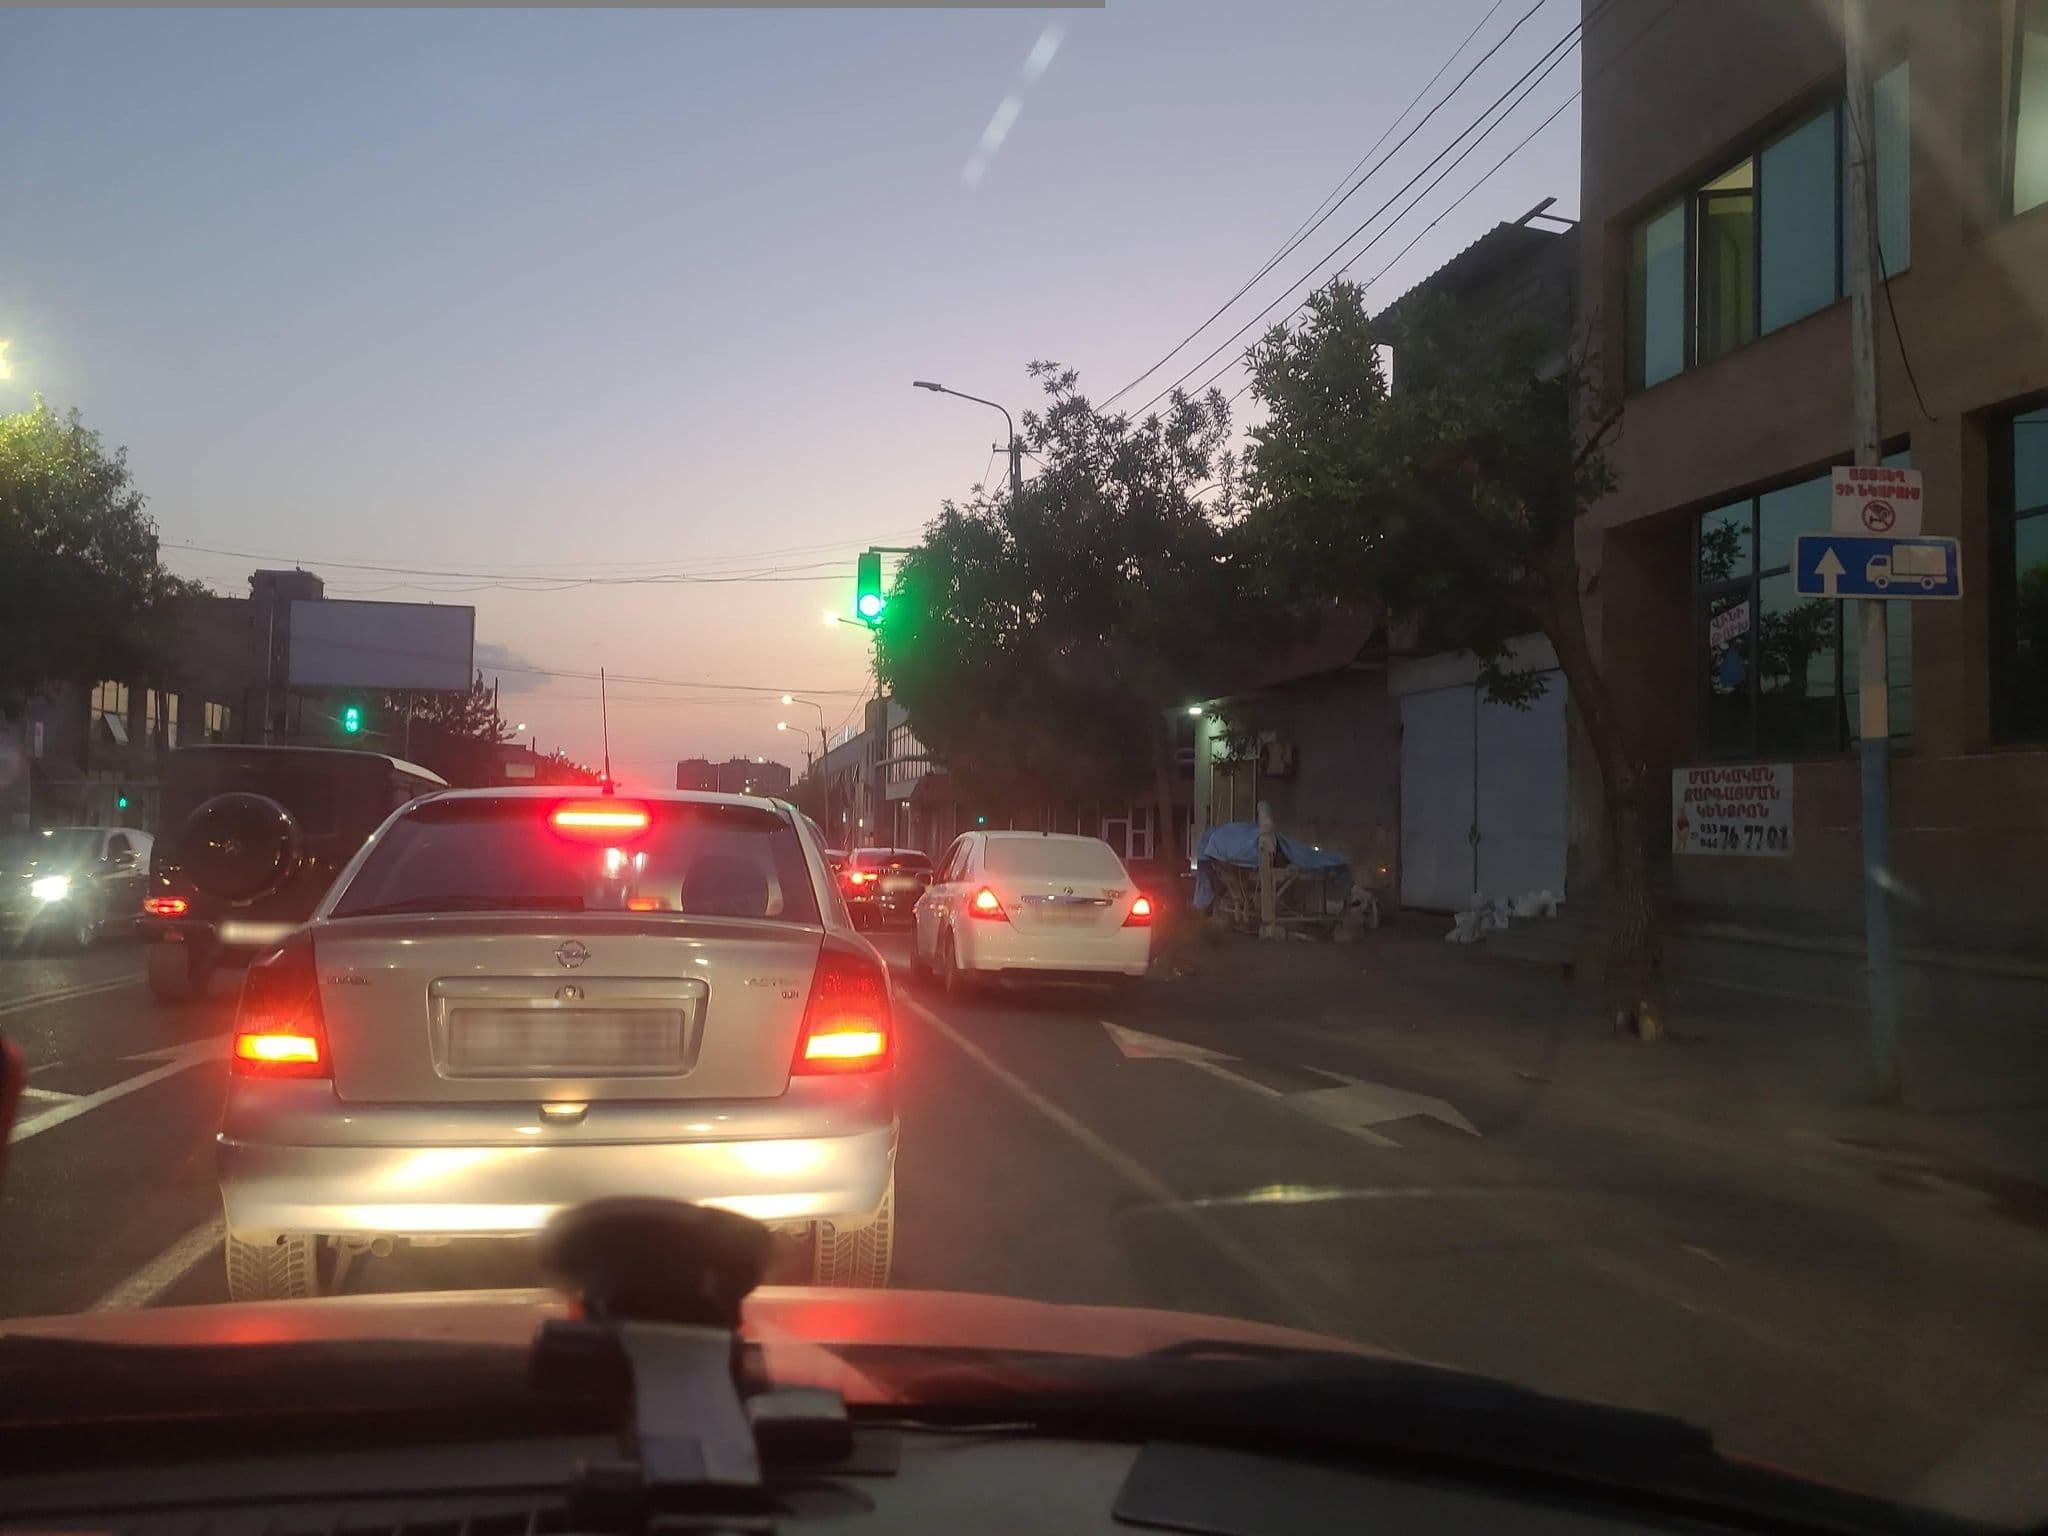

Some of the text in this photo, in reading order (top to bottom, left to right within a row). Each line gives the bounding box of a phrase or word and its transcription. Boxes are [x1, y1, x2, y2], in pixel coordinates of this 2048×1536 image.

[1688, 767, 1775, 785] ՄԱՆԿԱԿԱՆ
[1684, 784, 1781, 802] ԶԱՐԳԱՑՄԱՆ
[1696, 803, 1770, 818] ԿԵՆՏՐՈՆ
[1720, 824, 1739, 850] 76
[1744, 824, 1765, 850] 77
